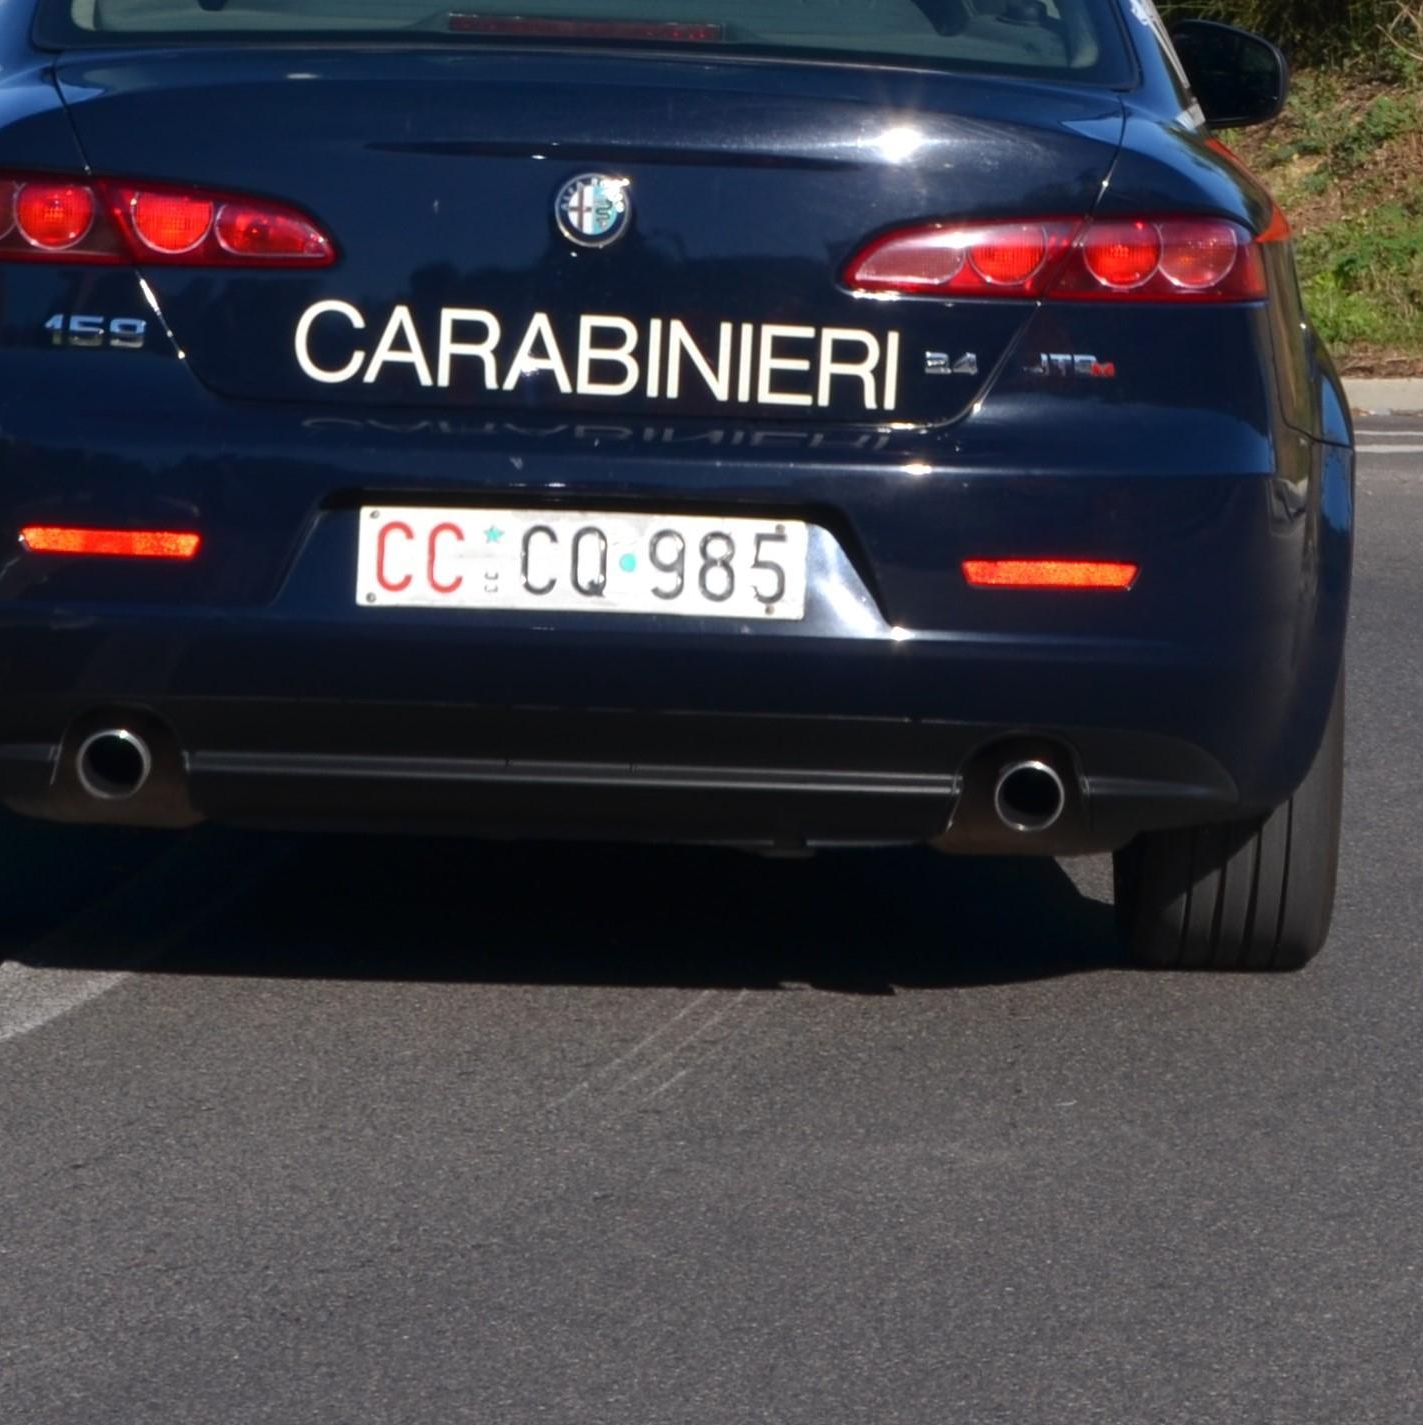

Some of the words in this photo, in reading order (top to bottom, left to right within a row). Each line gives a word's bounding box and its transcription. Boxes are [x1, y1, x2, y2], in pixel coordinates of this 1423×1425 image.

[44, 314, 148, 349] 159
[293, 298, 901, 412] CARABINIERI
[376, 520, 466, 594] CC
[520, 524, 609, 598] CQ
[648, 526, 789, 604] 985
